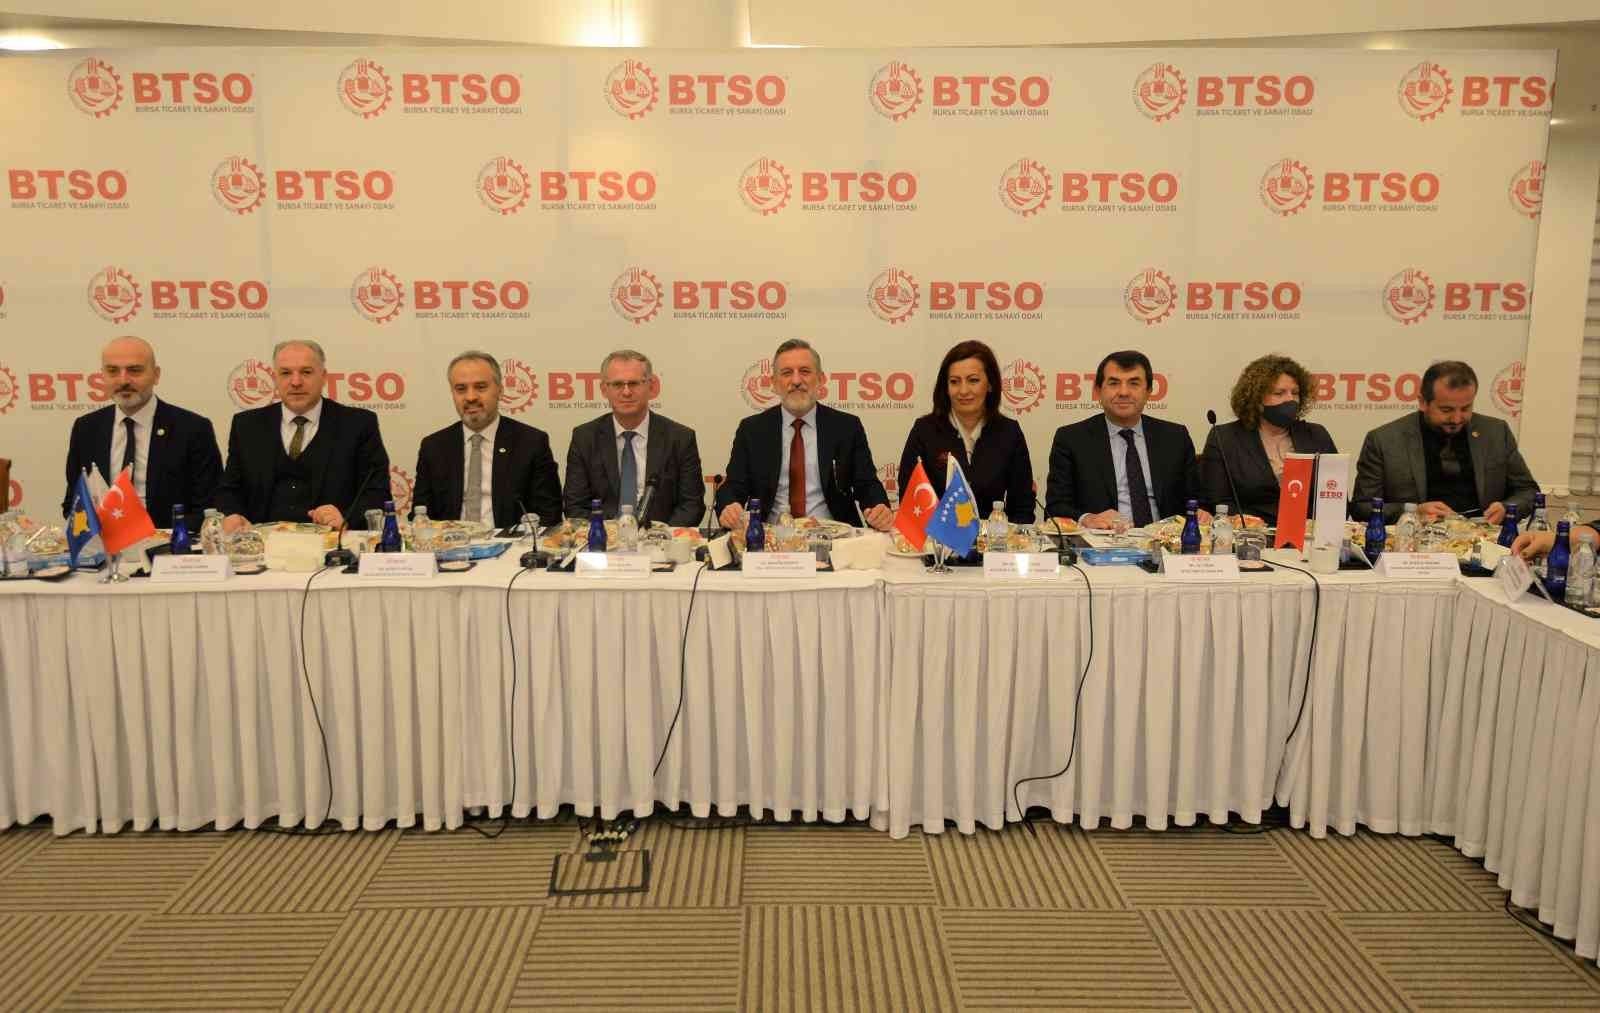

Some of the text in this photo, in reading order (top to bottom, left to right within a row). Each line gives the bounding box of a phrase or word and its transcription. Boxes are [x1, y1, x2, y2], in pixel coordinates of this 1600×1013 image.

[133, 72, 253, 104] BTSO
[404, 74, 520, 105] BTSO
[669, 74, 784, 106] BTSO
[933, 75, 1048, 108] BTSO
[1197, 75, 1313, 108] BTSO
[1462, 75, 1555, 108] BTS
[9, 169, 128, 201] BTSO
[277, 170, 392, 201] BTSO
[540, 171, 656, 202] BTSO
[803, 172, 916, 202] BTSO
[1063, 172, 1178, 204] BTSO
[1324, 171, 1440, 203] BTSO
[152, 280, 268, 310] BTSO
[414, 280, 528, 310] BTSO
[673, 281, 785, 310] BTSO
[932, 281, 1042, 310] BTSO
[1187, 282, 1300, 311] BTSO
[1445, 282, 1532, 312] BTS
[28, 373, 110, 401] BTS
[325, 372, 404, 401] TSO
[1056, 372, 1168, 401] BTO
[1311, 373, 1421, 402] BTSO
